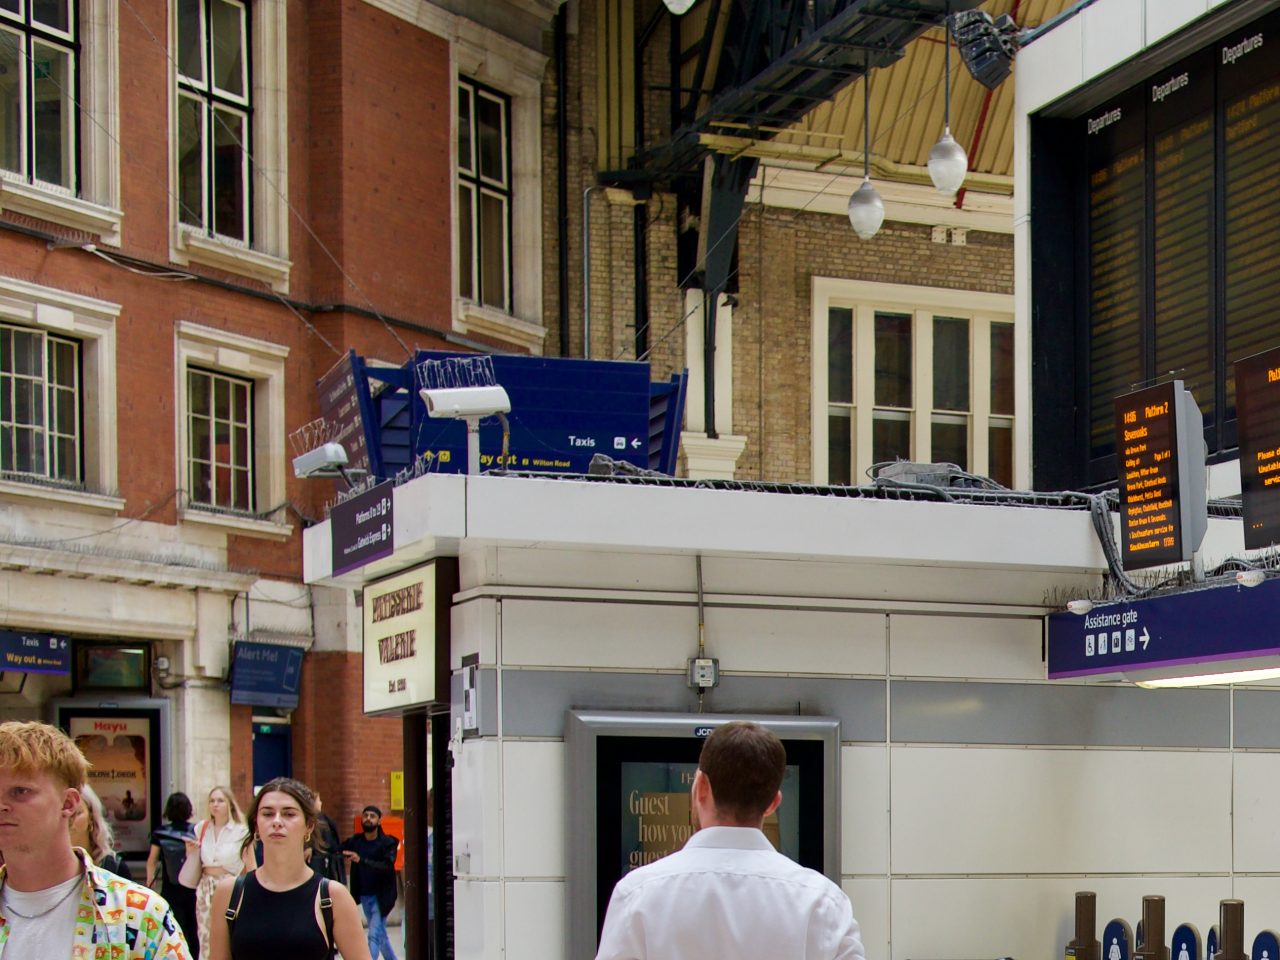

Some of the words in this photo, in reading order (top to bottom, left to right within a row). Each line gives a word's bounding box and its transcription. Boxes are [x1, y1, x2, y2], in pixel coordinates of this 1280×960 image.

[1222, 33, 1263, 64] Departures
[1152, 71, 1189, 103] Departures
[1088, 107, 1122, 135] Departures
[568, 435, 596, 447] Taxis
[480, 455, 493, 467] ay
[533, 459, 552, 467] Wilton
[1257, 450, 1275, 461] Please
[372, 581, 424, 624] PATISSERIE
[1084, 612, 1120, 630] Assistance
[1122, 609, 1138, 627] gate
[21, 636, 39, 647] Taxis
[378, 629, 416, 665] VALERIE
[6, 653, 23, 664] Way
[24, 655, 36, 664] out
[237, 647, 261, 660] Alert
[630, 790, 670, 816] Guest
[639, 816, 671, 842] how
